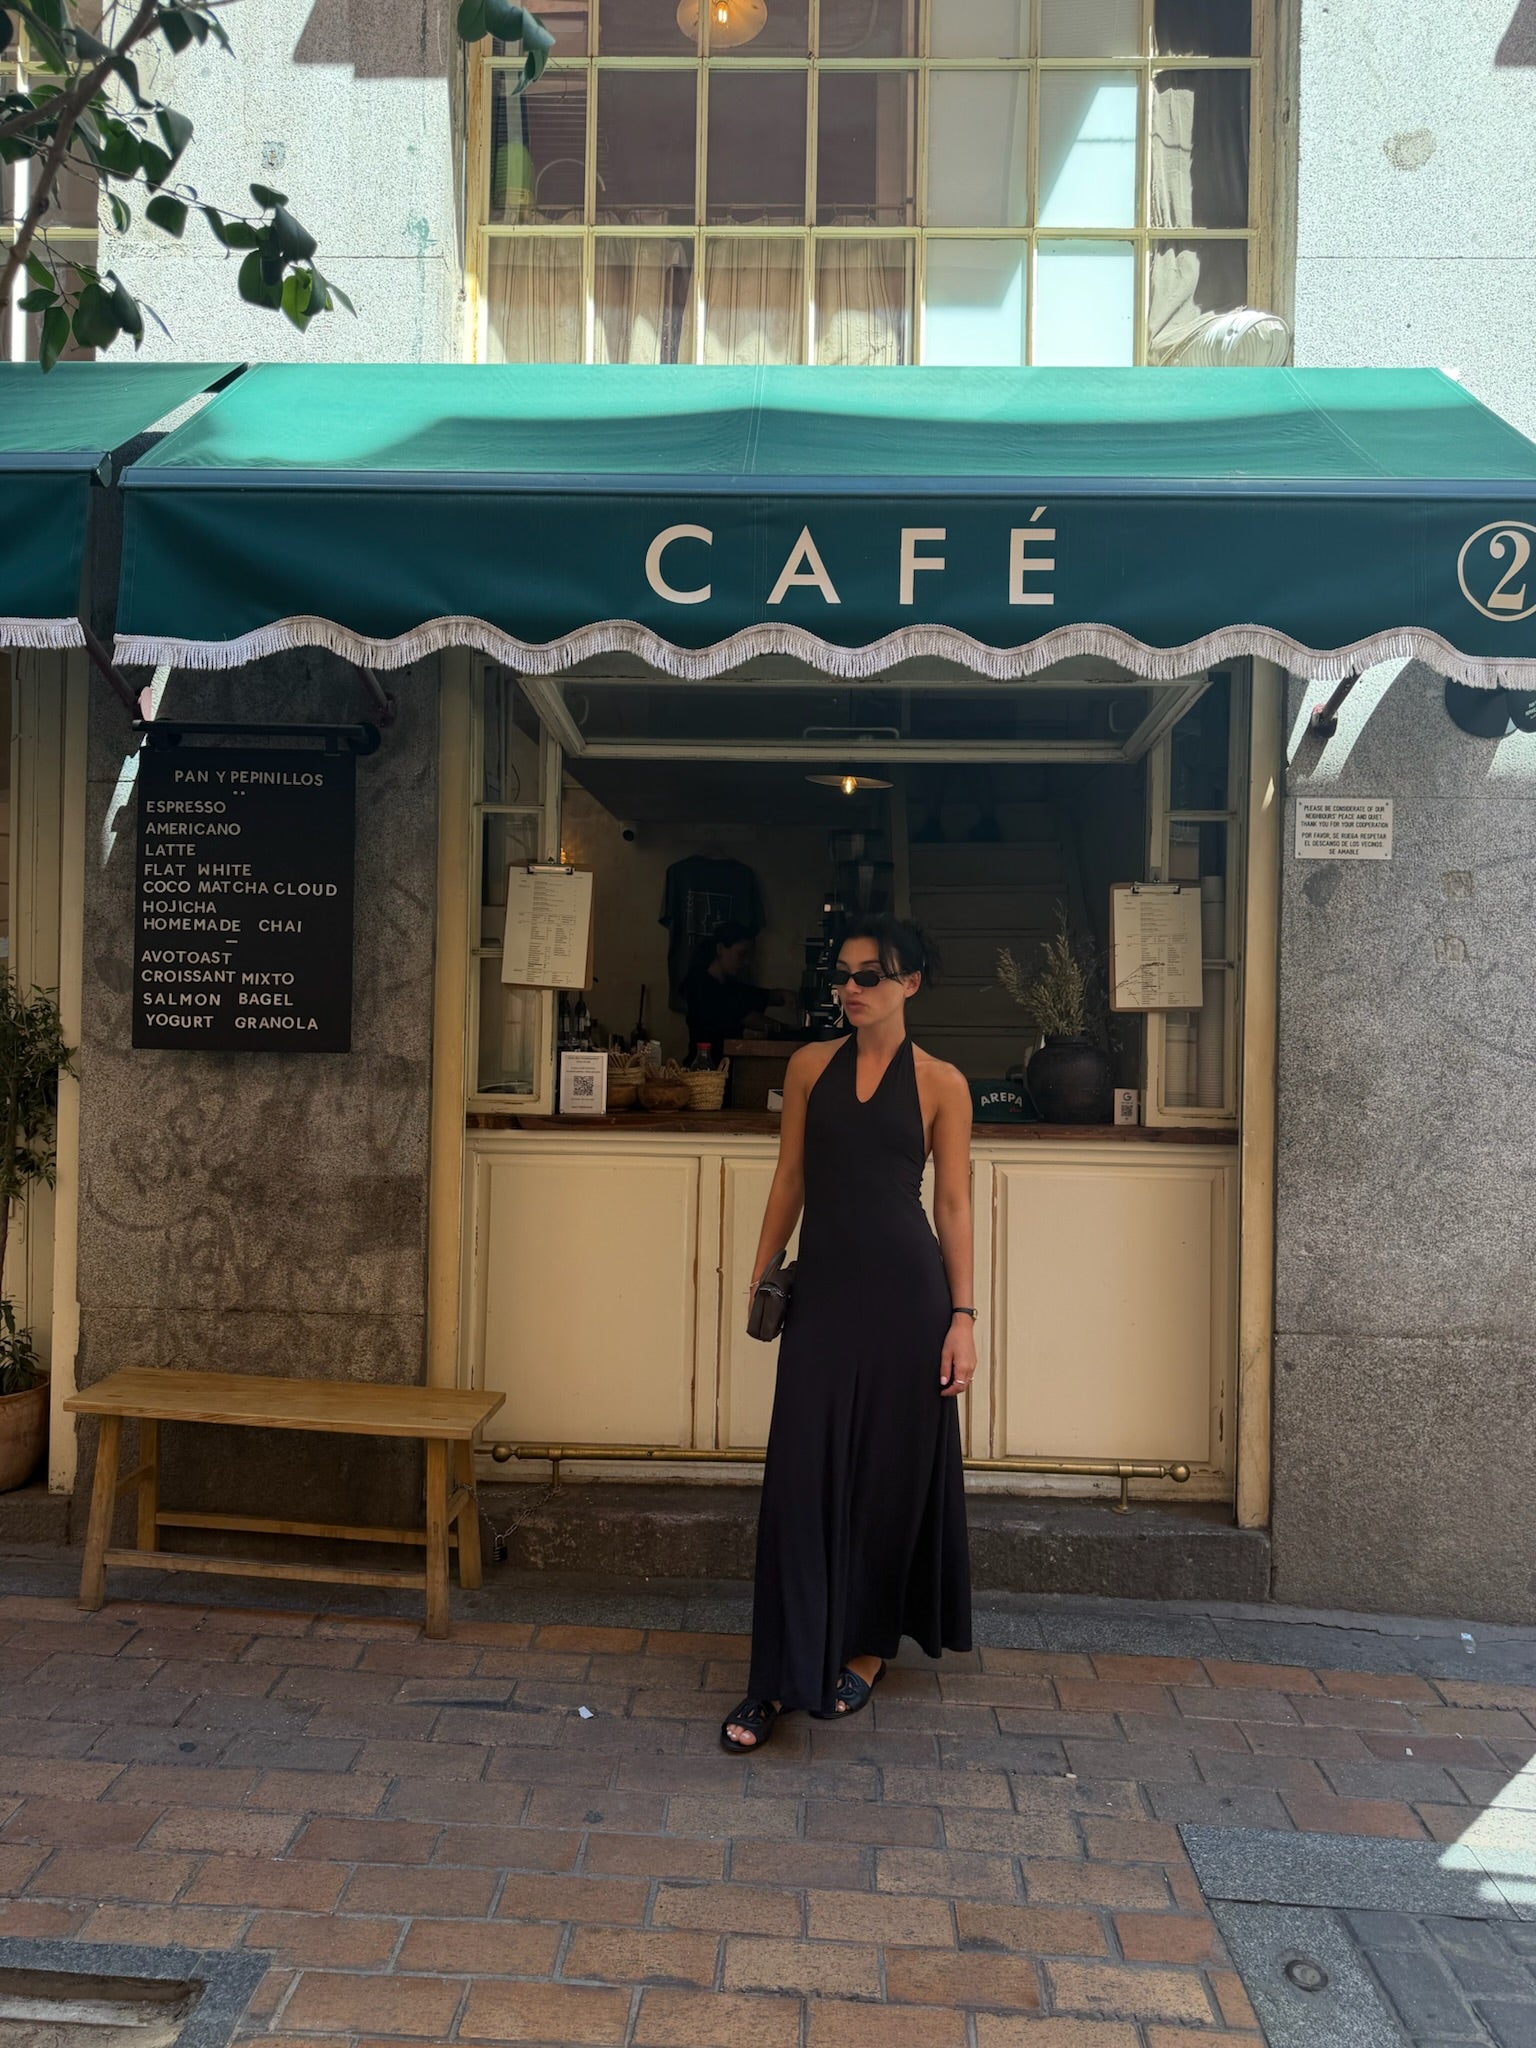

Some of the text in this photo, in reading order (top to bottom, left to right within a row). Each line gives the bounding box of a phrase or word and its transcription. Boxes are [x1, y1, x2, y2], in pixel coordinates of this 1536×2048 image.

[645, 506, 1056, 605] CAFÉ
[1487, 530, 1531, 610] 2
[174, 770, 324, 787] PAN Y PEPINILLOS
[146, 801, 226, 814] ESPRESSO
[145, 823, 241, 836] AMERICANO
[145, 844, 196, 856] LATTE
[144, 864, 252, 877] FLAT WHITE
[142, 881, 338, 896] COCO MATCHA CLOUD
[142, 901, 216, 914] HOJICHA
[143, 918, 302, 933] HOMEMADE CHAI
[141, 951, 232, 965] AVOTOAST
[141, 970, 295, 986] CROISSANT MIXTO
[143, 992, 293, 1006] SALMON BAGEL
[145, 1014, 319, 1030] YOGURT GRANOLA
[980, 1092, 1022, 1107] AREPA
